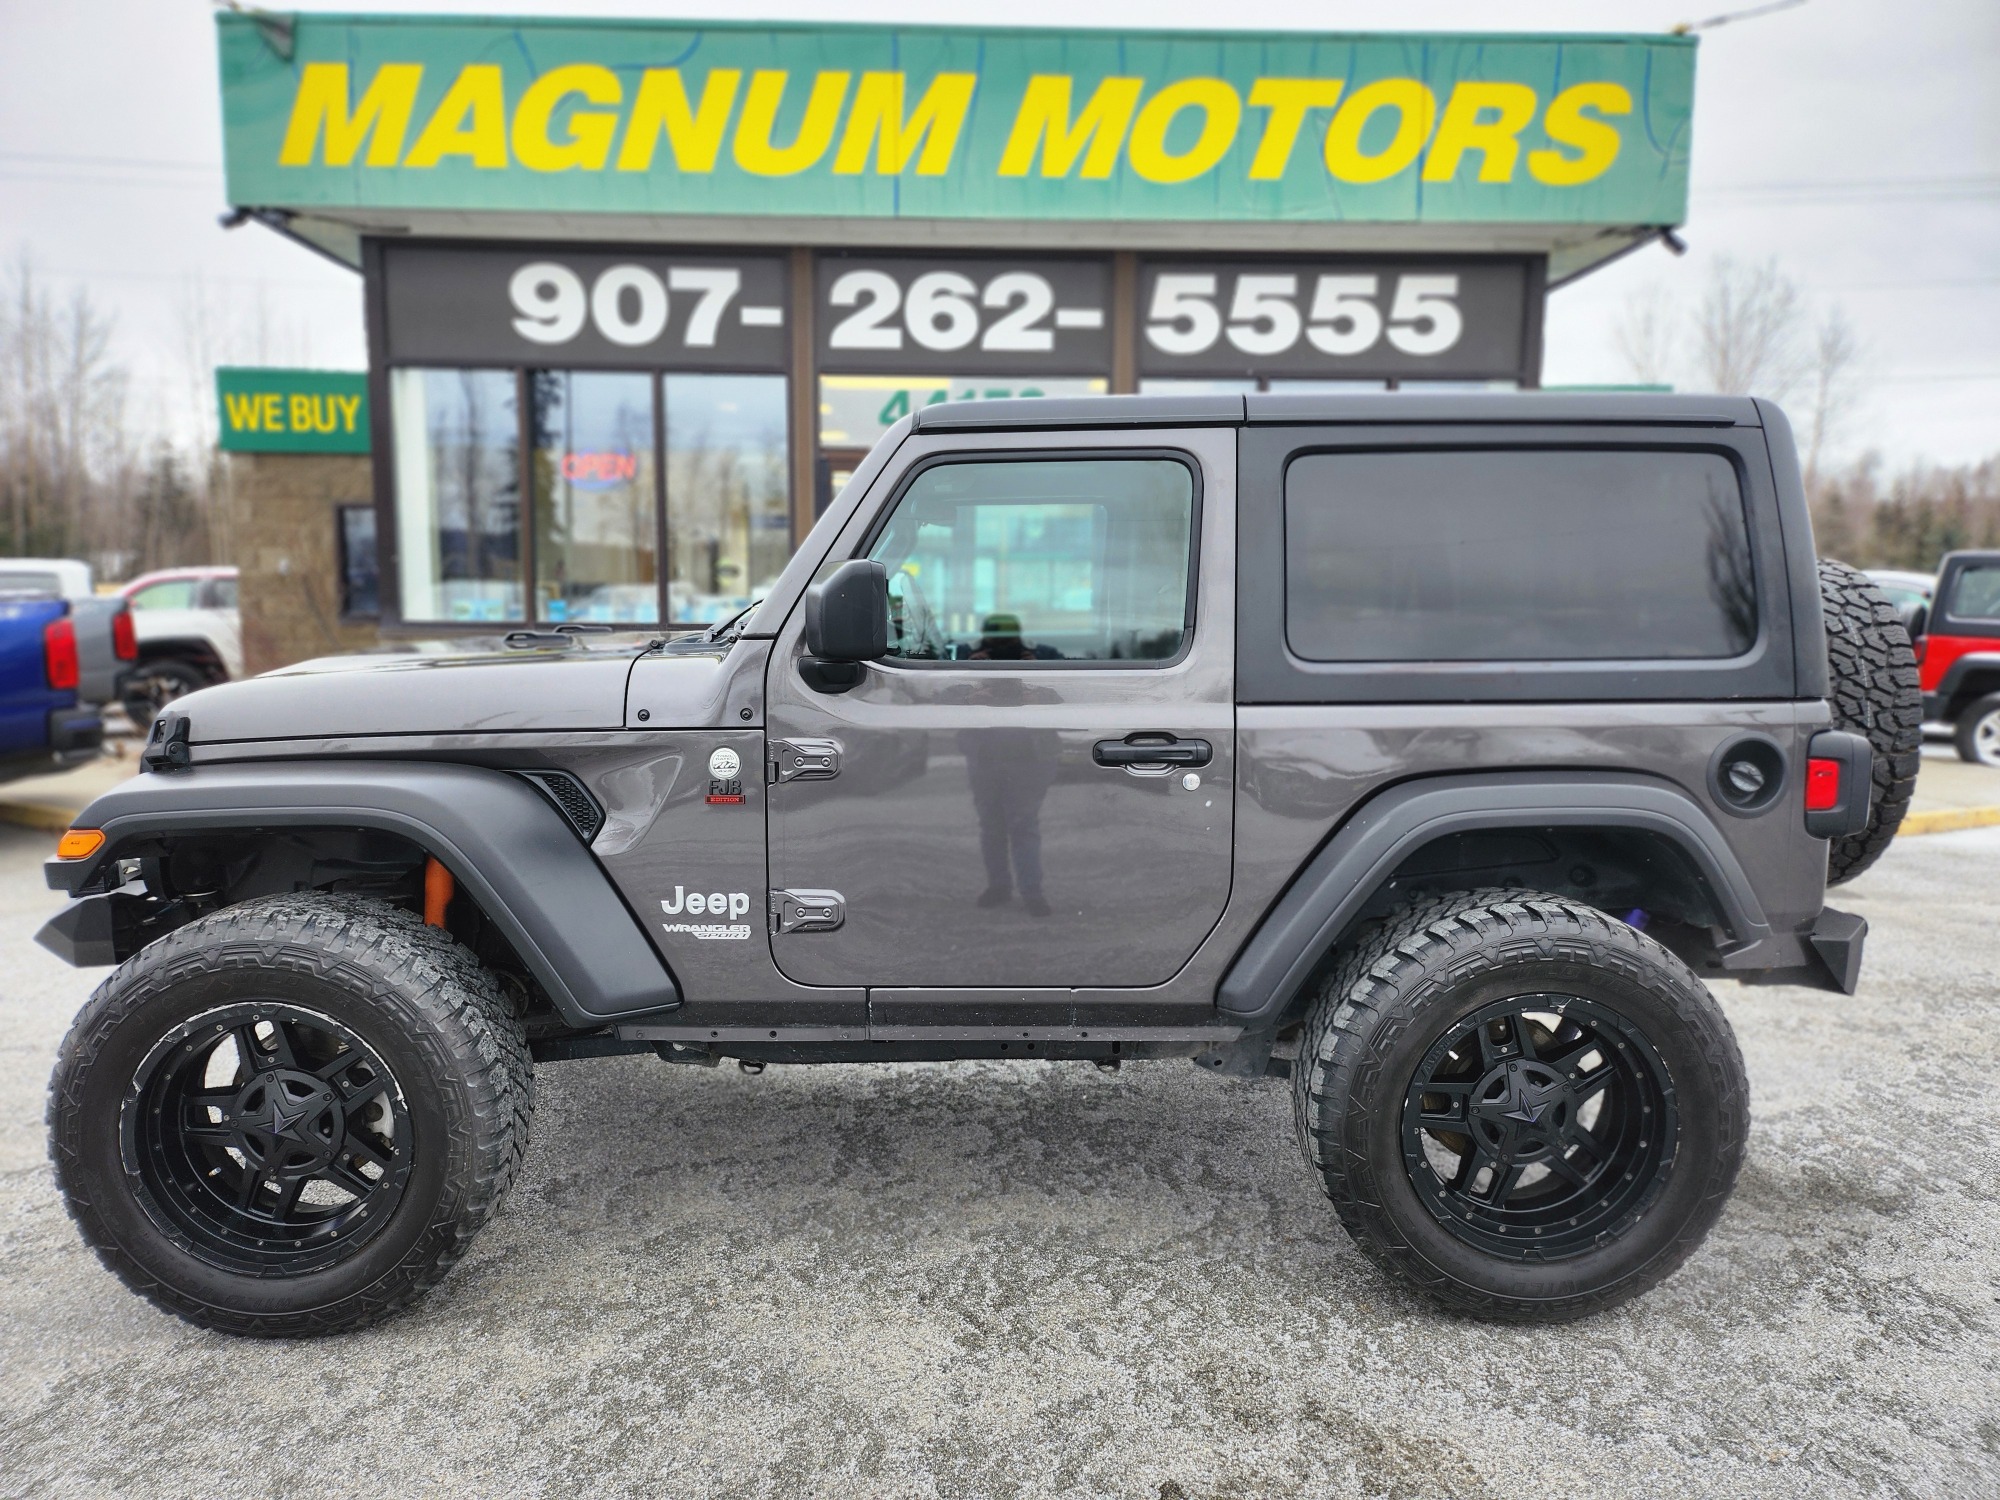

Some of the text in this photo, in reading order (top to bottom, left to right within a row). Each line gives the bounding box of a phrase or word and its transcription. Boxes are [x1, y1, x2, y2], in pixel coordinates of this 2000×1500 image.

[278, 62, 1632, 186] MAGNUM MOTORS
[509, 263, 1463, 355] 907- 262- 5555
[224, 393, 361, 434] WE BUY
[561, 451, 637, 481] OPEN
[709, 779, 742, 795] FJB
[661, 886, 750, 920] Jeep
[662, 924, 751, 932] WRANGLER
